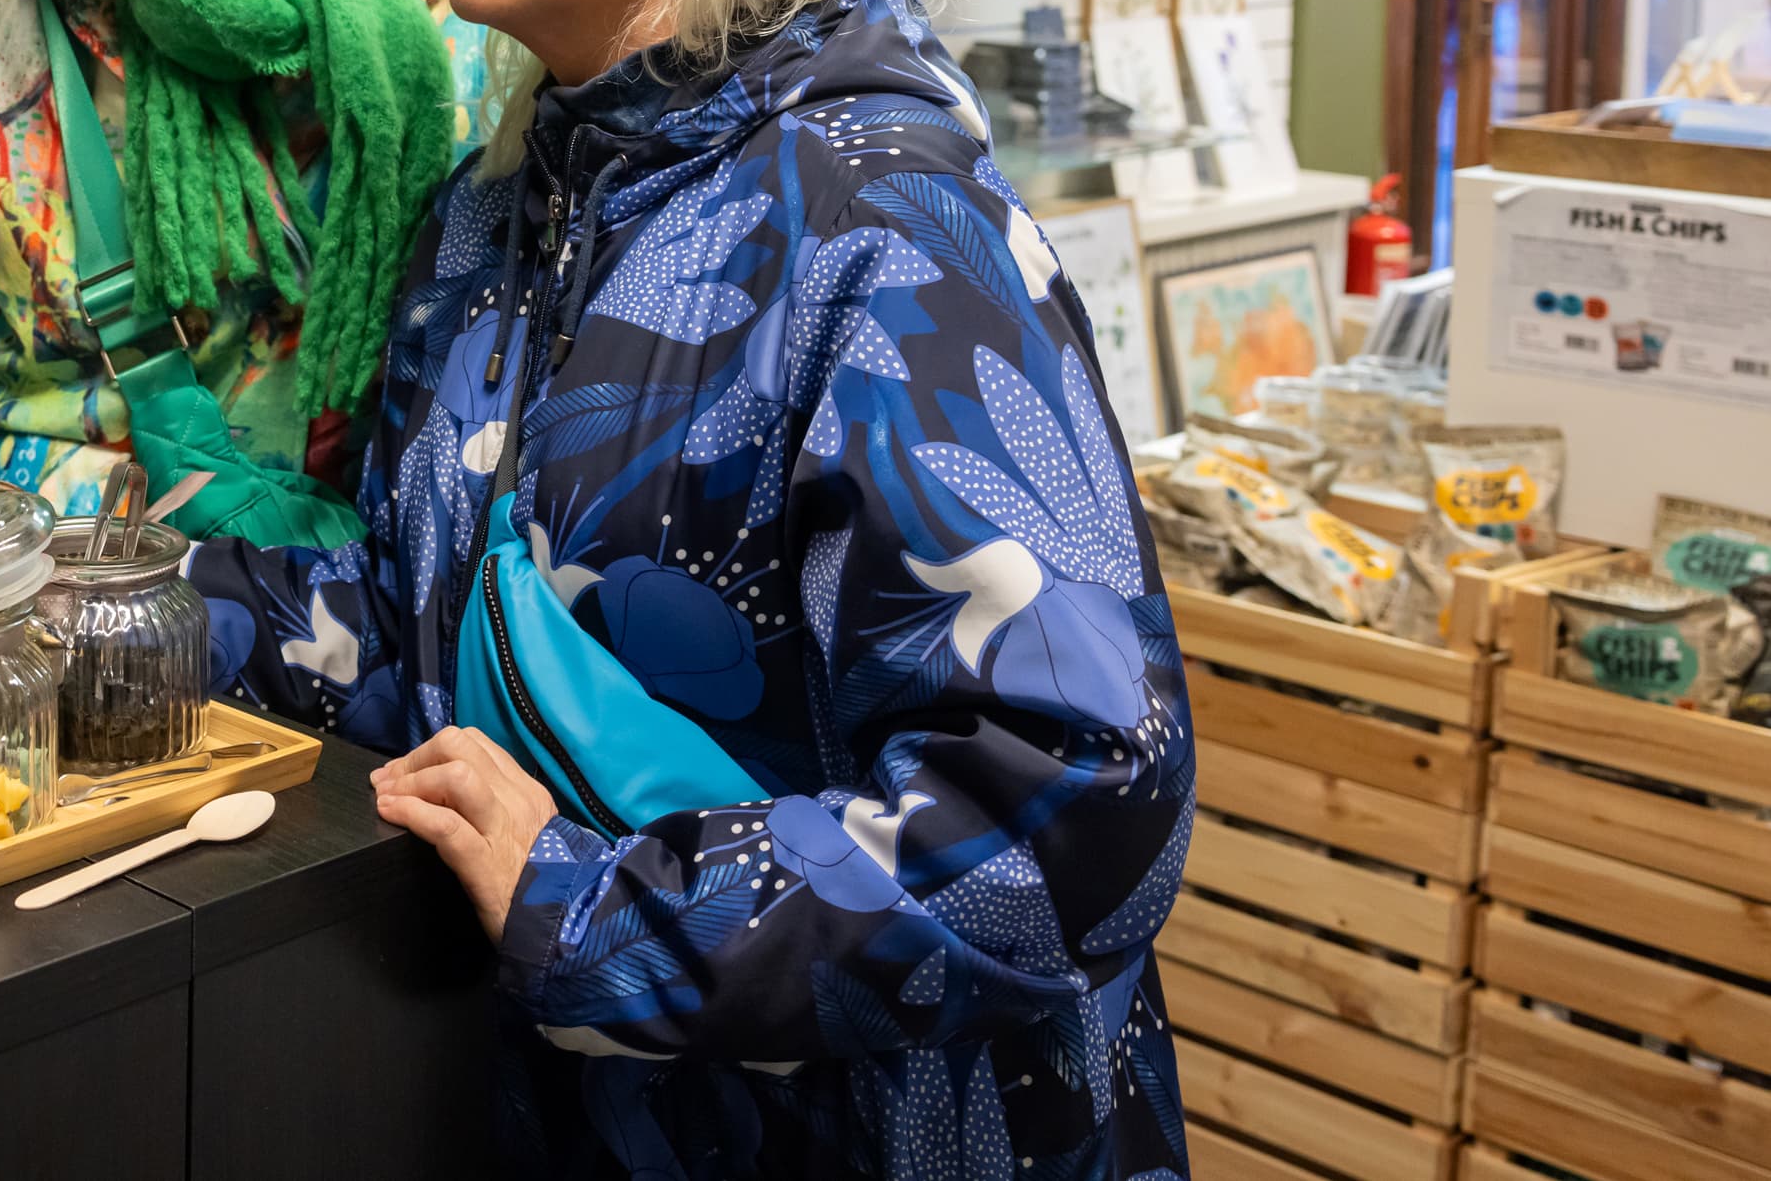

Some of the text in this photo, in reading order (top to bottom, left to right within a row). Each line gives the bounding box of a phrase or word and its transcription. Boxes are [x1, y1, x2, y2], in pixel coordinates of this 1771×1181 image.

[1569, 207, 1728, 244] FISH & CHIPS
